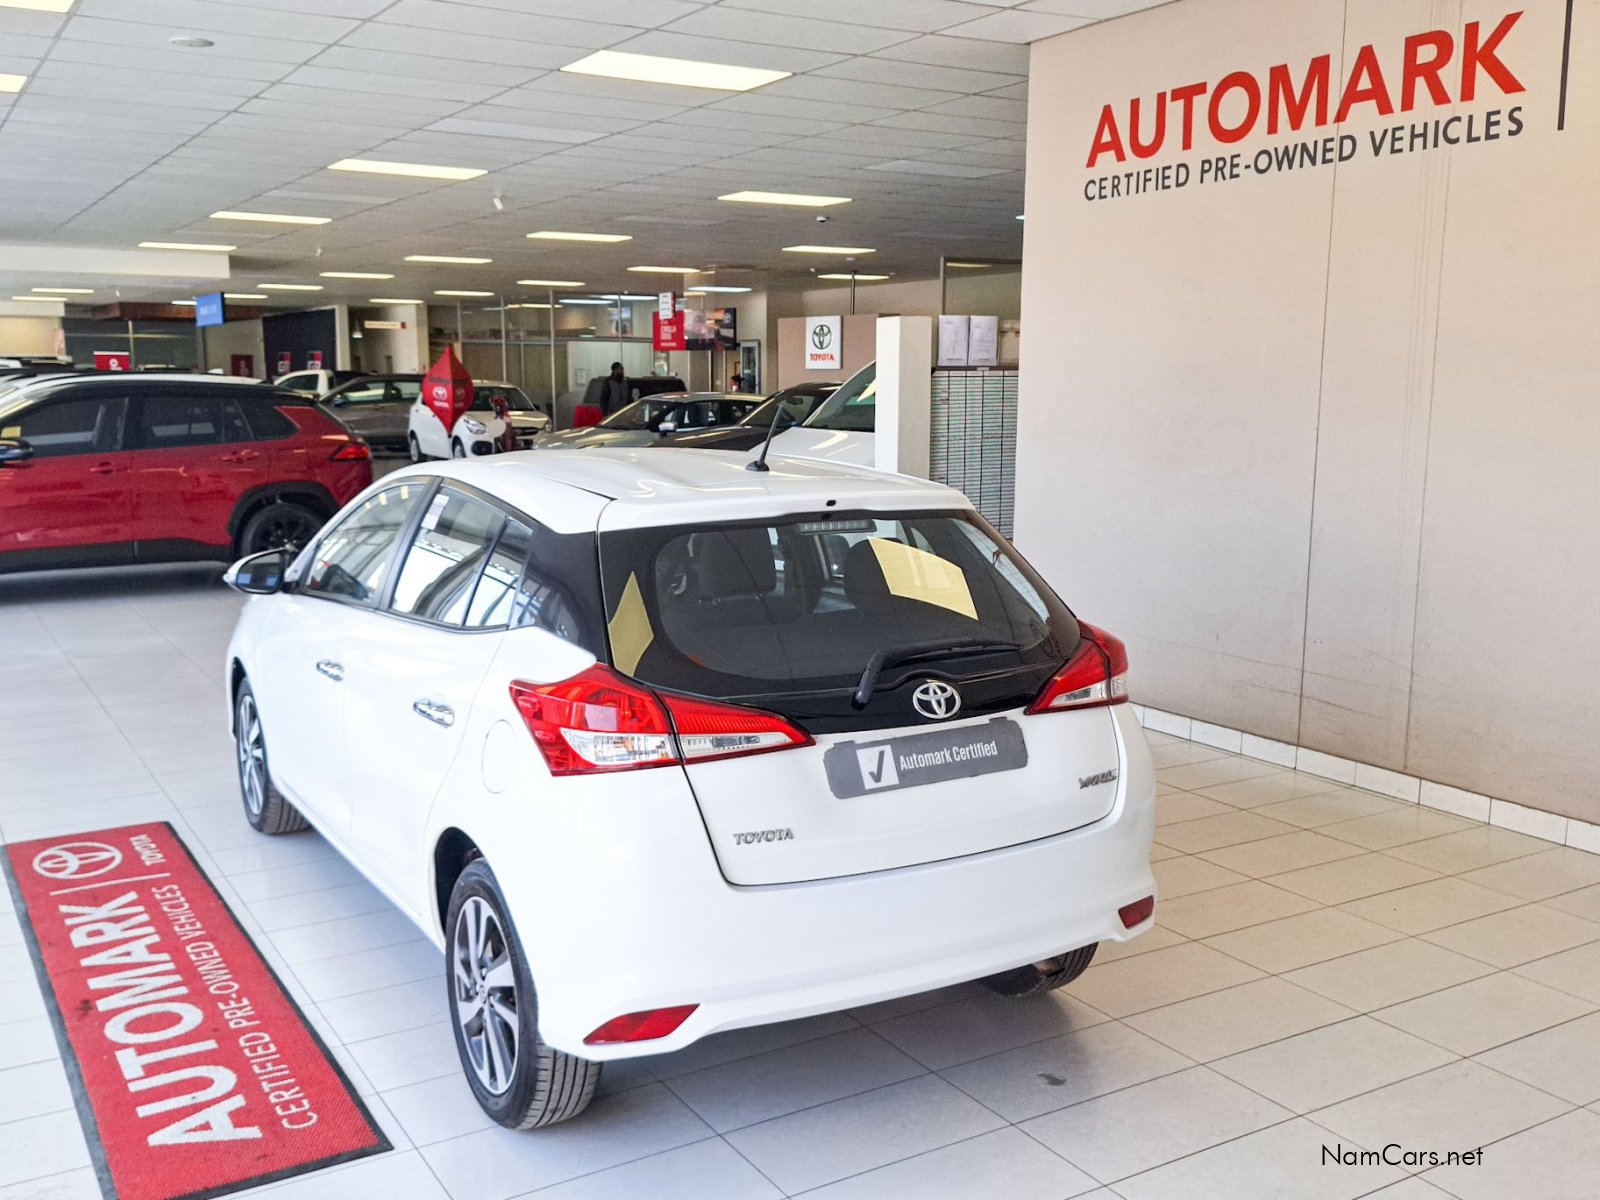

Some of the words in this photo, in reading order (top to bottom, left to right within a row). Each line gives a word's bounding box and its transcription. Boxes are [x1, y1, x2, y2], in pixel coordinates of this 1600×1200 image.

[1086, 10, 1526, 168] AUTOMARK
[1084, 162, 1190, 201] CERTIFIED
[1199, 134, 1357, 184] PRE-OWNED
[1369, 106, 1523, 157] VEHICLES
[810, 353, 835, 361] TOYOTA
[900, 748, 953, 771] Automark
[952, 740, 998, 762] Certified
[732, 828, 794, 845] TOYOTA
[151, 884, 207, 941] VEHICLES
[58, 891, 263, 1147] AUTOMARK
[185, 941, 261, 1030] PRE-OWNED
[238, 1031, 318, 1130] CERTIFIED
